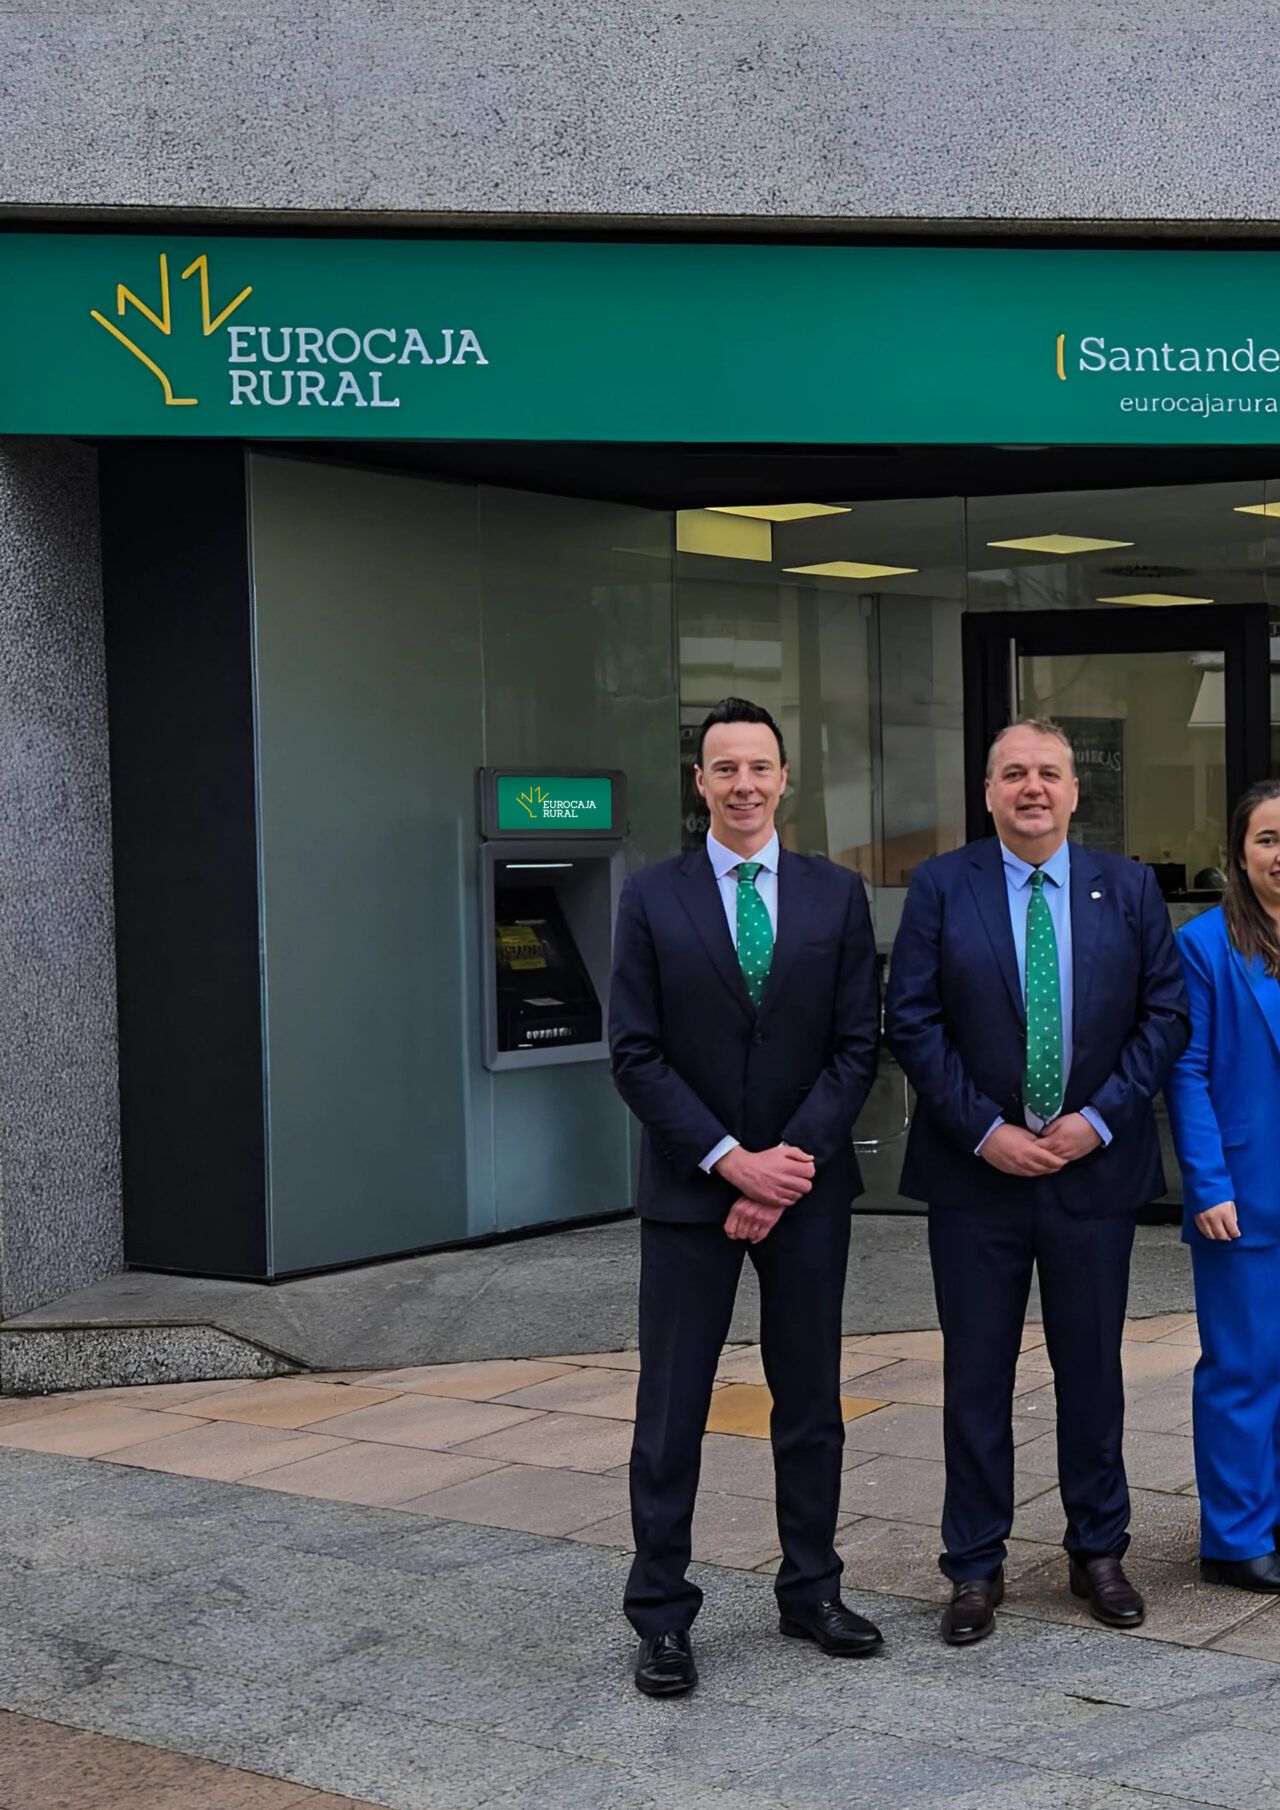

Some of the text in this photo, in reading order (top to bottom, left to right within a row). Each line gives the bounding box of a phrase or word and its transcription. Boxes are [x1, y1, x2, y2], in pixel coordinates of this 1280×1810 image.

[227, 326, 489, 365] EUROCAJA
[229, 370, 400, 407] RURAL
[543, 800, 597, 809] EUROCAJA
[543, 809, 578, 818] RURAL
